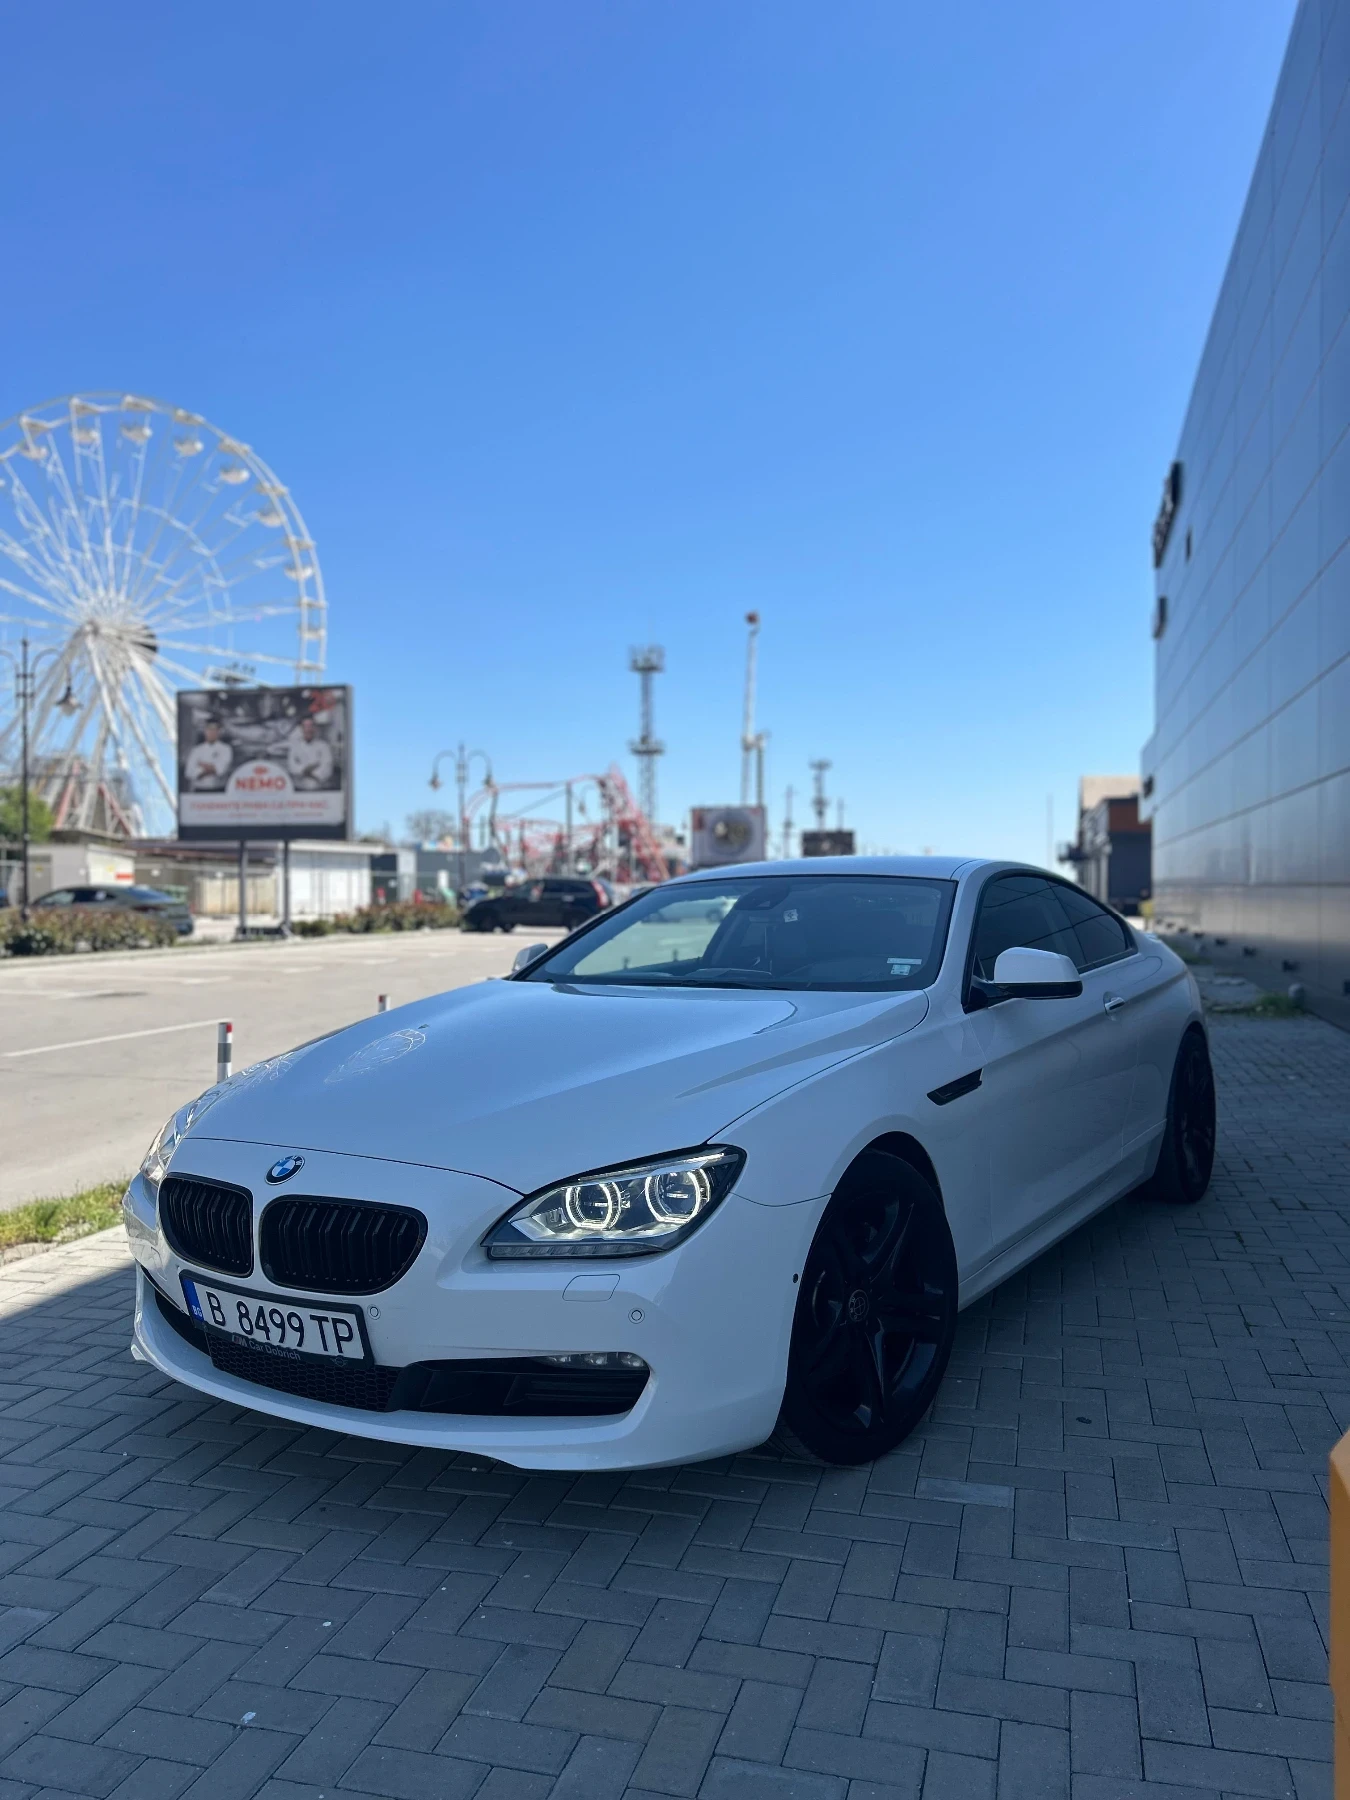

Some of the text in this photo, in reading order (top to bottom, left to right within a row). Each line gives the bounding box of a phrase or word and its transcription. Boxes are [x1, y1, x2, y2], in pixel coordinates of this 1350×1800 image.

[235, 776, 286, 791] NEMO
[206, 1291, 353, 1354] B 8499 TP
[249, 1340, 264, 1352] Car
[265, 1345, 301, 1361] Dobrich
